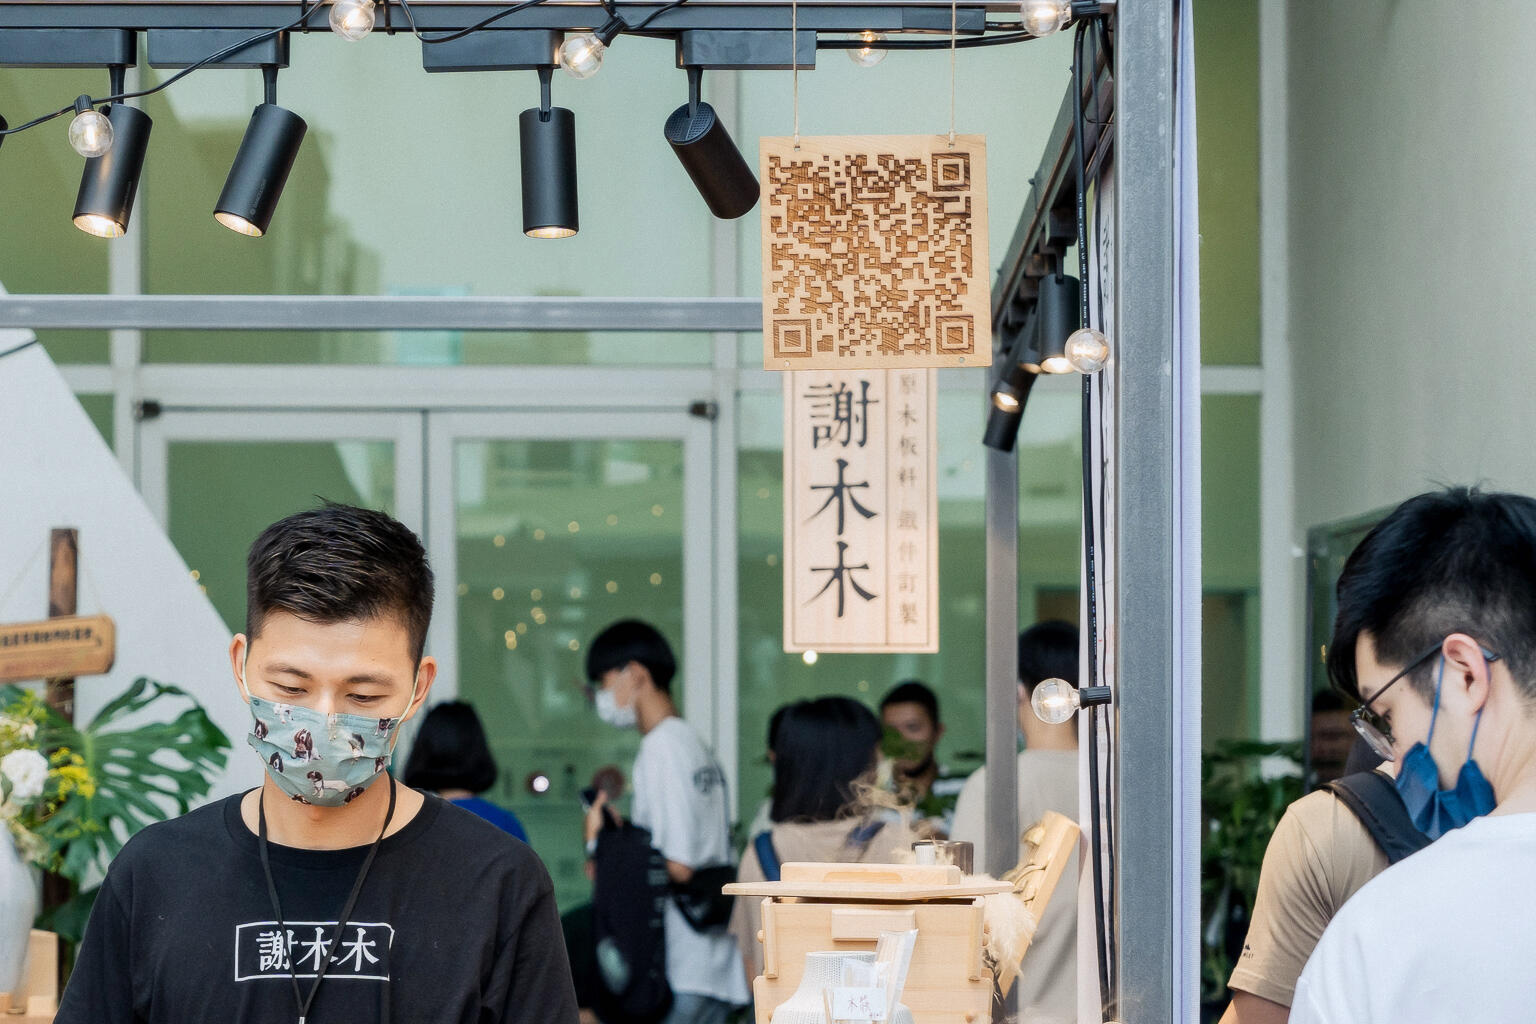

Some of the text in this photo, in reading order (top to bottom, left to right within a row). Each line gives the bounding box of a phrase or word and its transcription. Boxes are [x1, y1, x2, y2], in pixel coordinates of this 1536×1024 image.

[802, 379, 879, 618] 謝木木
[256, 926, 380, 972] 謝木木
